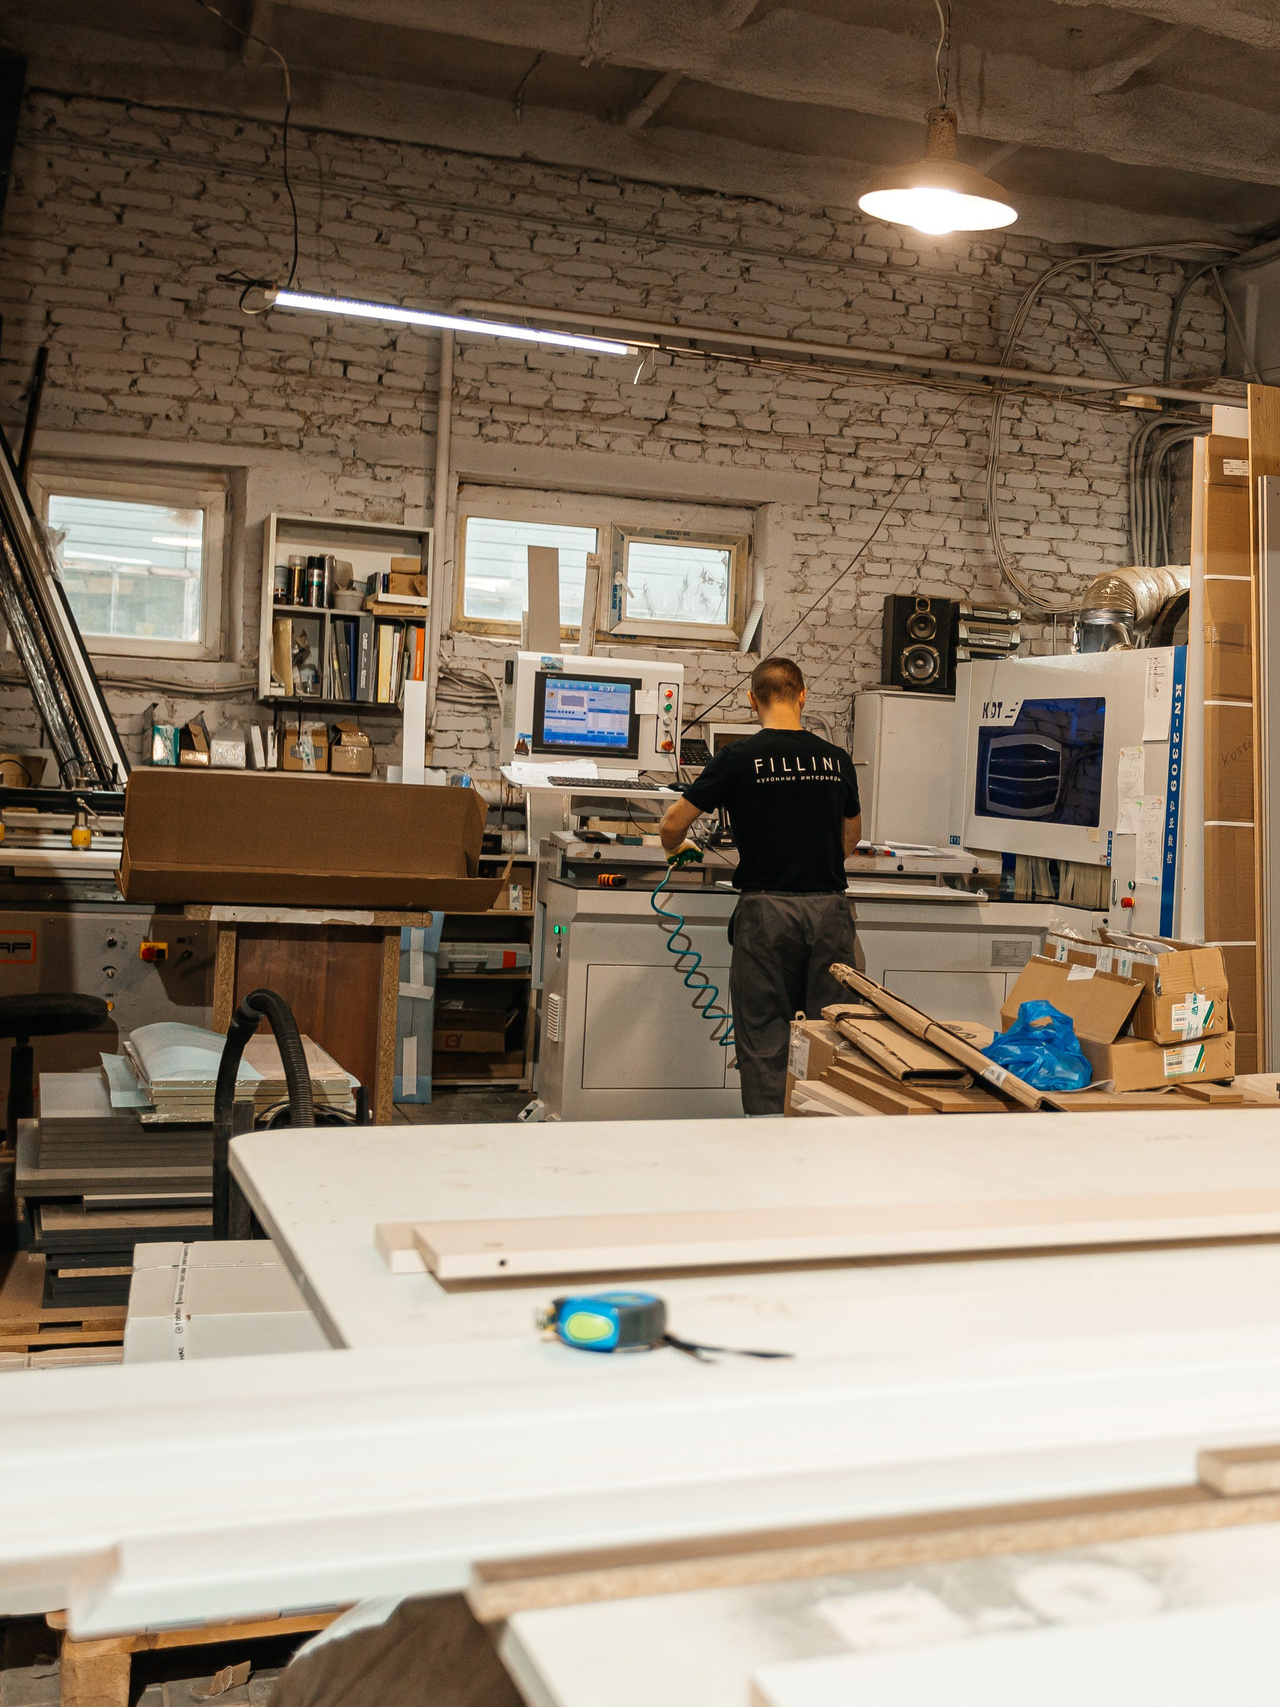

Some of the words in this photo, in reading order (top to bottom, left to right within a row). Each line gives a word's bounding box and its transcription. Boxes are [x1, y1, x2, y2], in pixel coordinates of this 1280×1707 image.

[982, 701, 1003, 719] KDT
[1170, 683, 1183, 792] KN-2309
[754, 756, 841, 773] FILLINI
